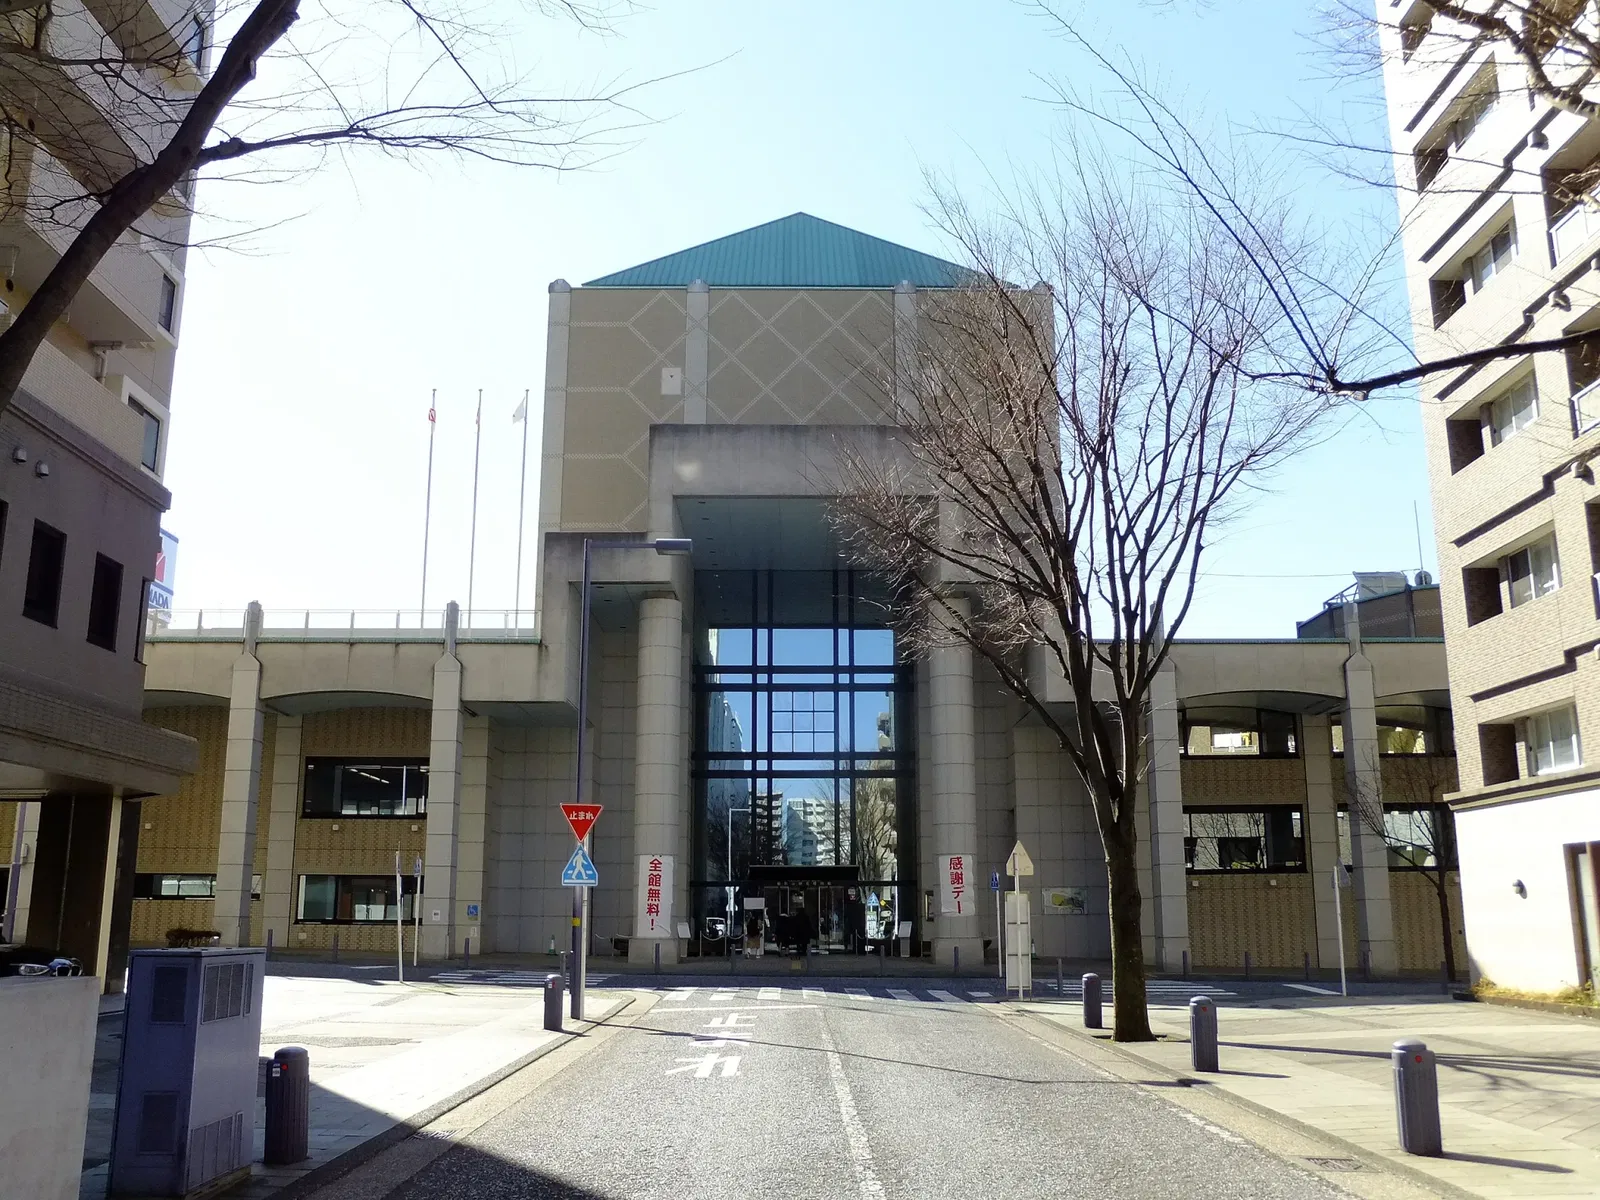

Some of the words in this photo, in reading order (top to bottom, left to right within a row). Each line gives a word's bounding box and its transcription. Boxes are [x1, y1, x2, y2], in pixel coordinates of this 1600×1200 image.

[569, 810, 595, 820] 止まれ
[949, 856, 965, 914] 感謝デー
